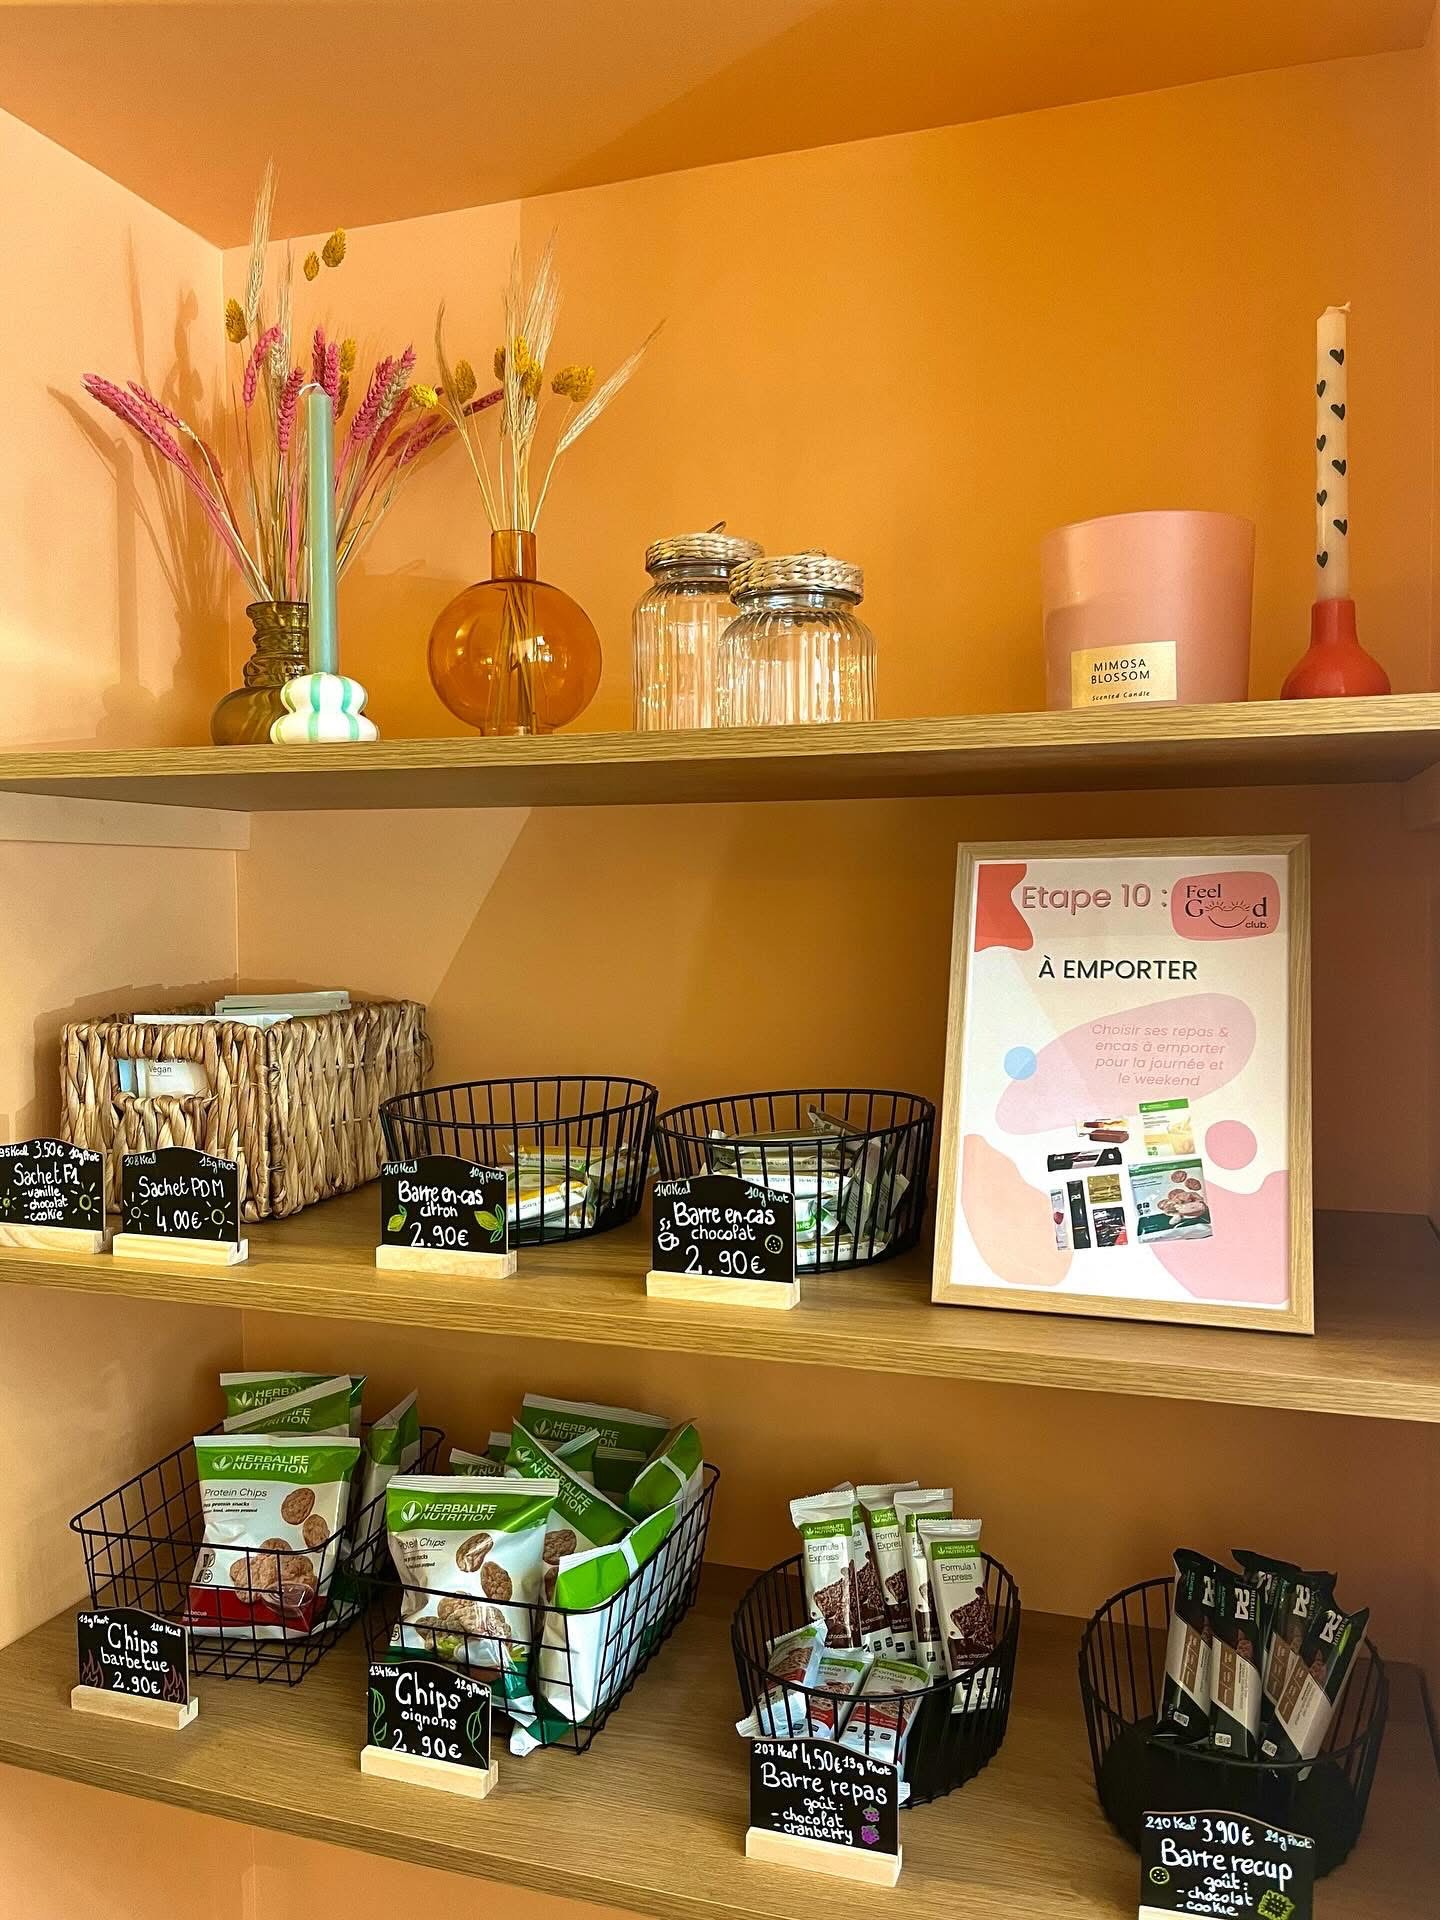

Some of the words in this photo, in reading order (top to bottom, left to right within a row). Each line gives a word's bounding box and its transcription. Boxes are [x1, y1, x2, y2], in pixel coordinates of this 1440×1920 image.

[1094, 659, 1146, 672] MIMOSA
[1091, 670, 1150, 684] BLOSSOM
[1092, 693, 1120, 701] Scented
[1022, 885, 1112, 916] Etape
[1121, 883, 1151, 908] 10
[1186, 884, 1221, 899] Feel
[1038, 955, 1056, 979] À
[1063, 959, 1198, 980] EMPORTER
[1091, 1024, 1140, 1036] Choisir
[1143, 1026, 1168, 1036] ses
[1172, 1026, 1214, 1039] repas
[1219, 1027, 1230, 1038] &
[1095, 1042, 1139, 1051] encas
[1142, 1041, 1153, 1052] à
[1157, 1043, 1225, 1056] emporter
[1095, 1058, 1129, 1069] pour
[1133, 1057, 1146, 1068] la
[1149, 1057, 1205, 1072] journée
[1209, 1060, 1224, 1071] et
[1118, 1073, 1131, 1084] le
[1135, 1075, 1200, 1086] weekend
[33, 1140, 64, 1159] 3.50€
[13, 1161, 62, 1186] Sachet
[63, 1163, 80, 1185] F1
[139, 1176, 189, 1197] Sachet
[191, 1177, 224, 1198] PDM
[398, 1180, 439, 1202] Barre
[157, 1205, 202, 1232] 4.00€
[420, 1202, 458, 1217] citron
[673, 1201, 721, 1226] Barre
[410, 1222, 469, 1247] 2.90€
[691, 1224, 757, 1241] chocolat
[684, 1245, 766, 1275] 2.90€
[232, 1462, 308, 1474] NUTRITION
[235, 1455, 309, 1465] HERBALIFE
[205, 1489, 237, 1497] Protein
[240, 1488, 267, 1498] Chips
[420, 1512, 493, 1521] NUTRITION
[424, 1504, 497, 1513] HERBALIFE
[420, 1538, 446, 1548] Chips
[875, 1532, 900, 1540] Formu
[808, 1543, 839, 1552] Formula
[809, 1554, 839, 1563] Express
[942, 1574, 973, 1582] Express
[108, 1623, 158, 1664] Chips
[101, 1646, 170, 1673] barbecue
[112, 1671, 161, 1694] 2.90€
[395, 1671, 461, 1719] Chips
[401, 1708, 457, 1731] oignons
[392, 1728, 462, 1759] 2.90€
[754, 1743, 774, 1755] 207
[777, 1743, 798, 1759] Kcal
[801, 1743, 843, 1774] 4.50€
[760, 1762, 824, 1793] Barre
[830, 1780, 887, 1806] repas
[1145, 1816, 1171, 1830] 210
[1172, 1816, 1197, 1831] Kcal
[1201, 1819, 1255, 1846] 3.90€
[1161, 1838, 1227, 1870] Barre
[1231, 1856, 1293, 1892] recup
